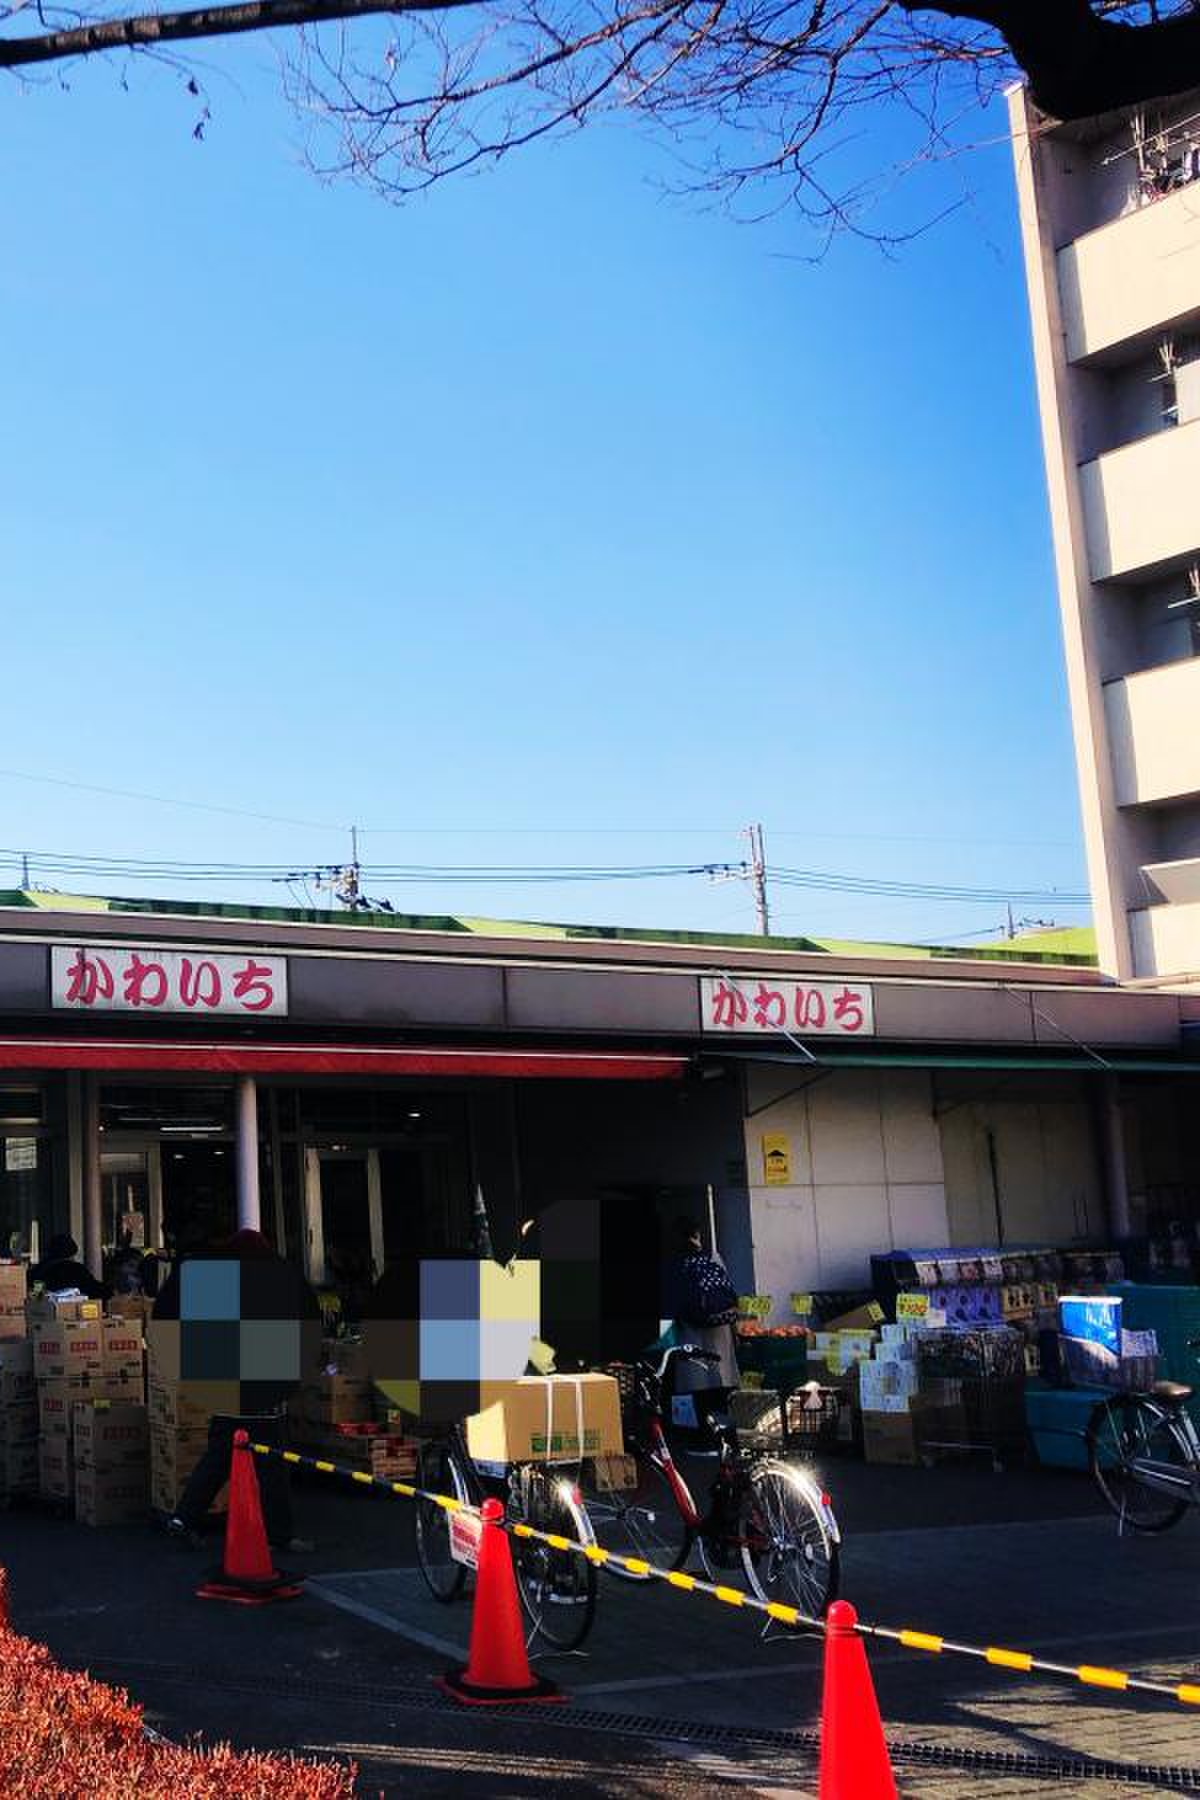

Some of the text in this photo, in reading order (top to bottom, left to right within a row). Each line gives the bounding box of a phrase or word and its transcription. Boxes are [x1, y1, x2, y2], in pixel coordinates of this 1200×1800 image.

[64, 950, 274, 1012] かわいち
[712, 981, 863, 1032] かわいち
